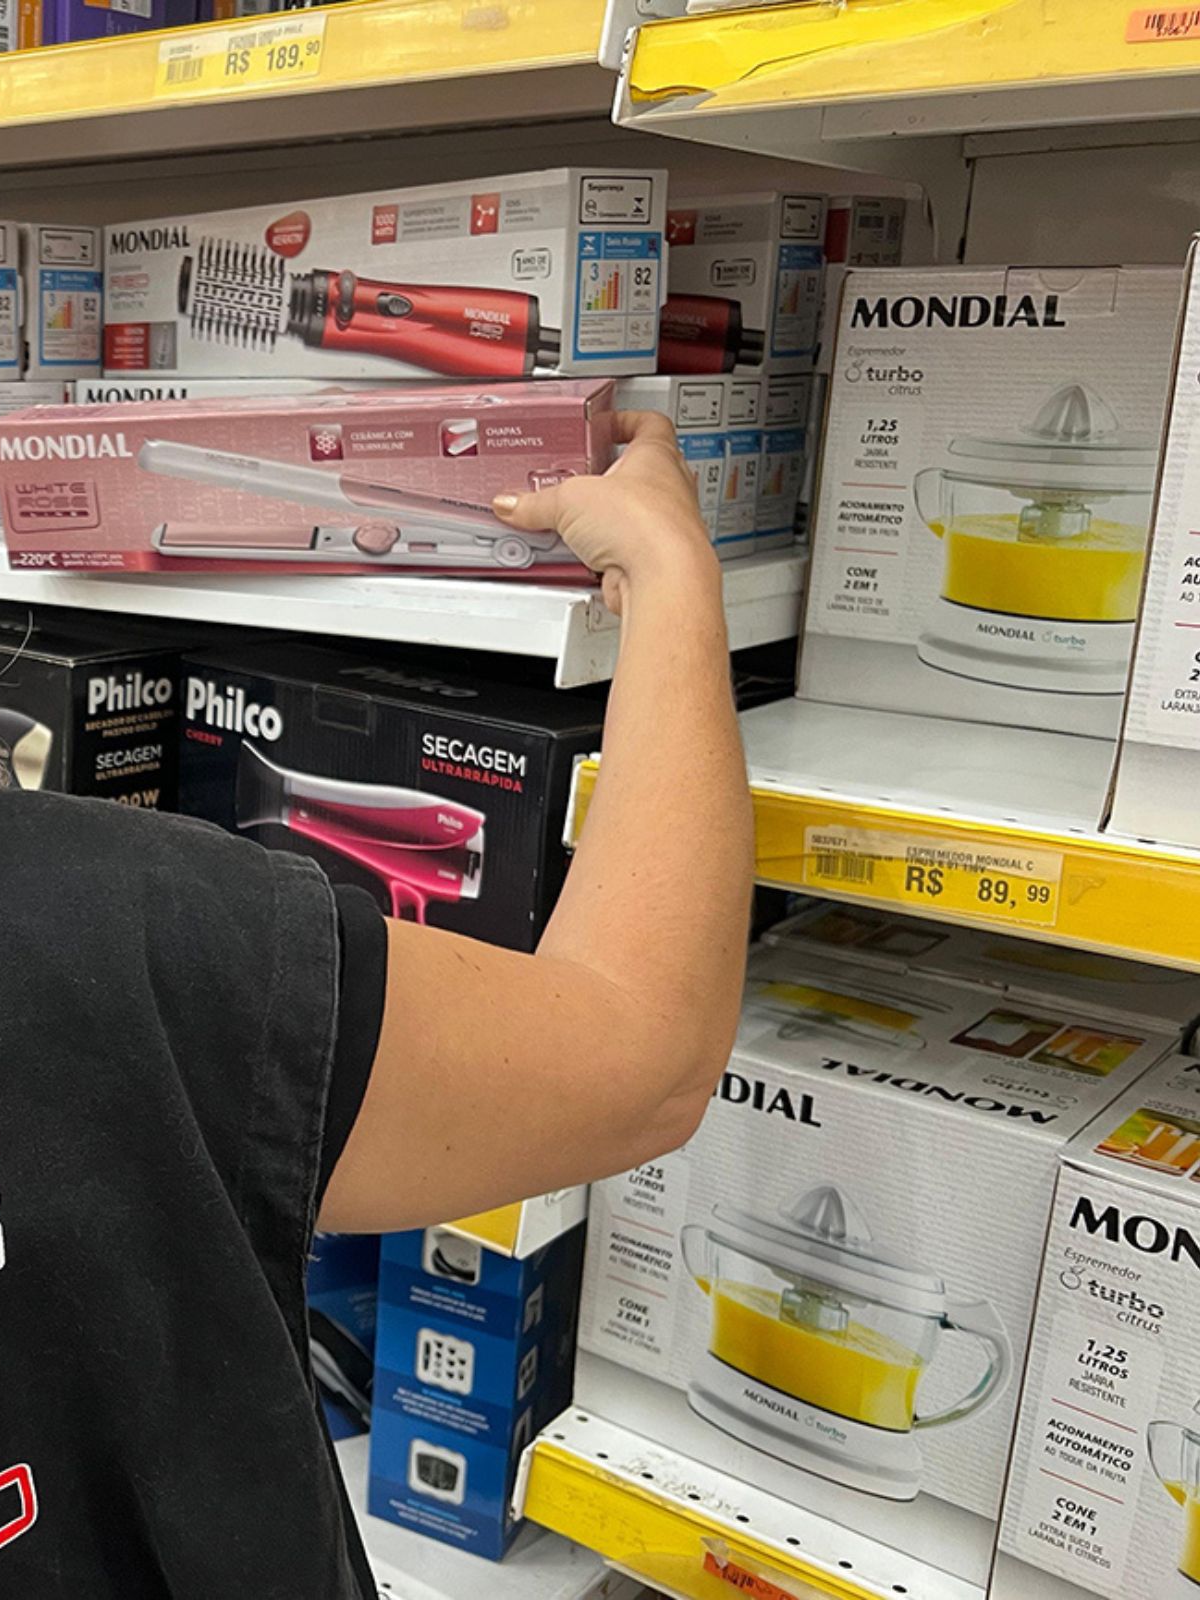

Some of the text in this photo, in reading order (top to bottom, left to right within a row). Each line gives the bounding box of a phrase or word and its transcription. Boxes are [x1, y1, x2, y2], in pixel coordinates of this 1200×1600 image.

[225, 51, 251, 75] R$
[110, 226, 191, 255] MONDIAL
[634, 267, 652, 285] 82
[851, 295, 1066, 328] MONDIAL
[866, 364, 924, 382] turbo
[888, 384, 922, 396] citrus
[394, 431, 415, 440] COM
[485, 426, 522, 437] CHAPAS
[866, 419, 898, 432] 1,25
[0, 433, 133, 461] MONDIAL
[487, 437, 544, 448] FLUTUANTES
[860, 434, 899, 445] LITROS
[16, 482, 86, 495] WHITE
[18, 497, 88, 509] ROSE
[839, 501, 905, 513] ACIONAMENTO
[837, 511, 903, 525] AUTOMÁTICO
[846, 567, 878, 579] CONE
[843, 581, 879, 592] 2 EM 1
[976, 623, 1036, 641] MONDIAL
[1053, 635, 1086, 646] turbo
[88, 672, 173, 715] Philco
[1174, 689, 1200, 700] EXTR
[186, 677, 283, 742] Philco
[1161, 700, 1200, 713] LARANJ
[185, 728, 223, 746] CHERRY
[95, 744, 162, 771] SECAGEM
[422, 733, 526, 776] SECAGEM
[421, 757, 523, 794] ULTRARRÁPIDA
[906, 846, 974, 864] ESPREMEDOR
[976, 854, 1022, 870] MONDIAL
[1026, 861, 1034, 871] C
[905, 866, 944, 897] R$
[711, 1072, 822, 1128] DIAL
[822, 1056, 1058, 1125] MONDIAL
[628, 1175, 666, 1193] LITROS
[1063, 1246, 1142, 1282] Espremedor
[618, 1296, 649, 1316] CONE
[1087, 1279, 1165, 1319] turbo
[625, 1312, 642, 1326] EM
[1115, 1310, 1163, 1335] citrus
[1086, 1338, 1129, 1364] 1,25
[1077, 1353, 1130, 1380] LITROS
[1081, 1369, 1115, 1391] JARRA
[743, 1387, 800, 1422] MONDIAL
[1068, 1377, 1128, 1409] RESISTENTE
[1047, 1418, 1135, 1459] ACIONAMENTO
[1046, 1430, 1132, 1472] AUTOMÁTICO
[1055, 1497, 1098, 1521] CONE
[1051, 1509, 1097, 1537] 2 EM 1
[1027, 1527, 1065, 1551] LARANJA
